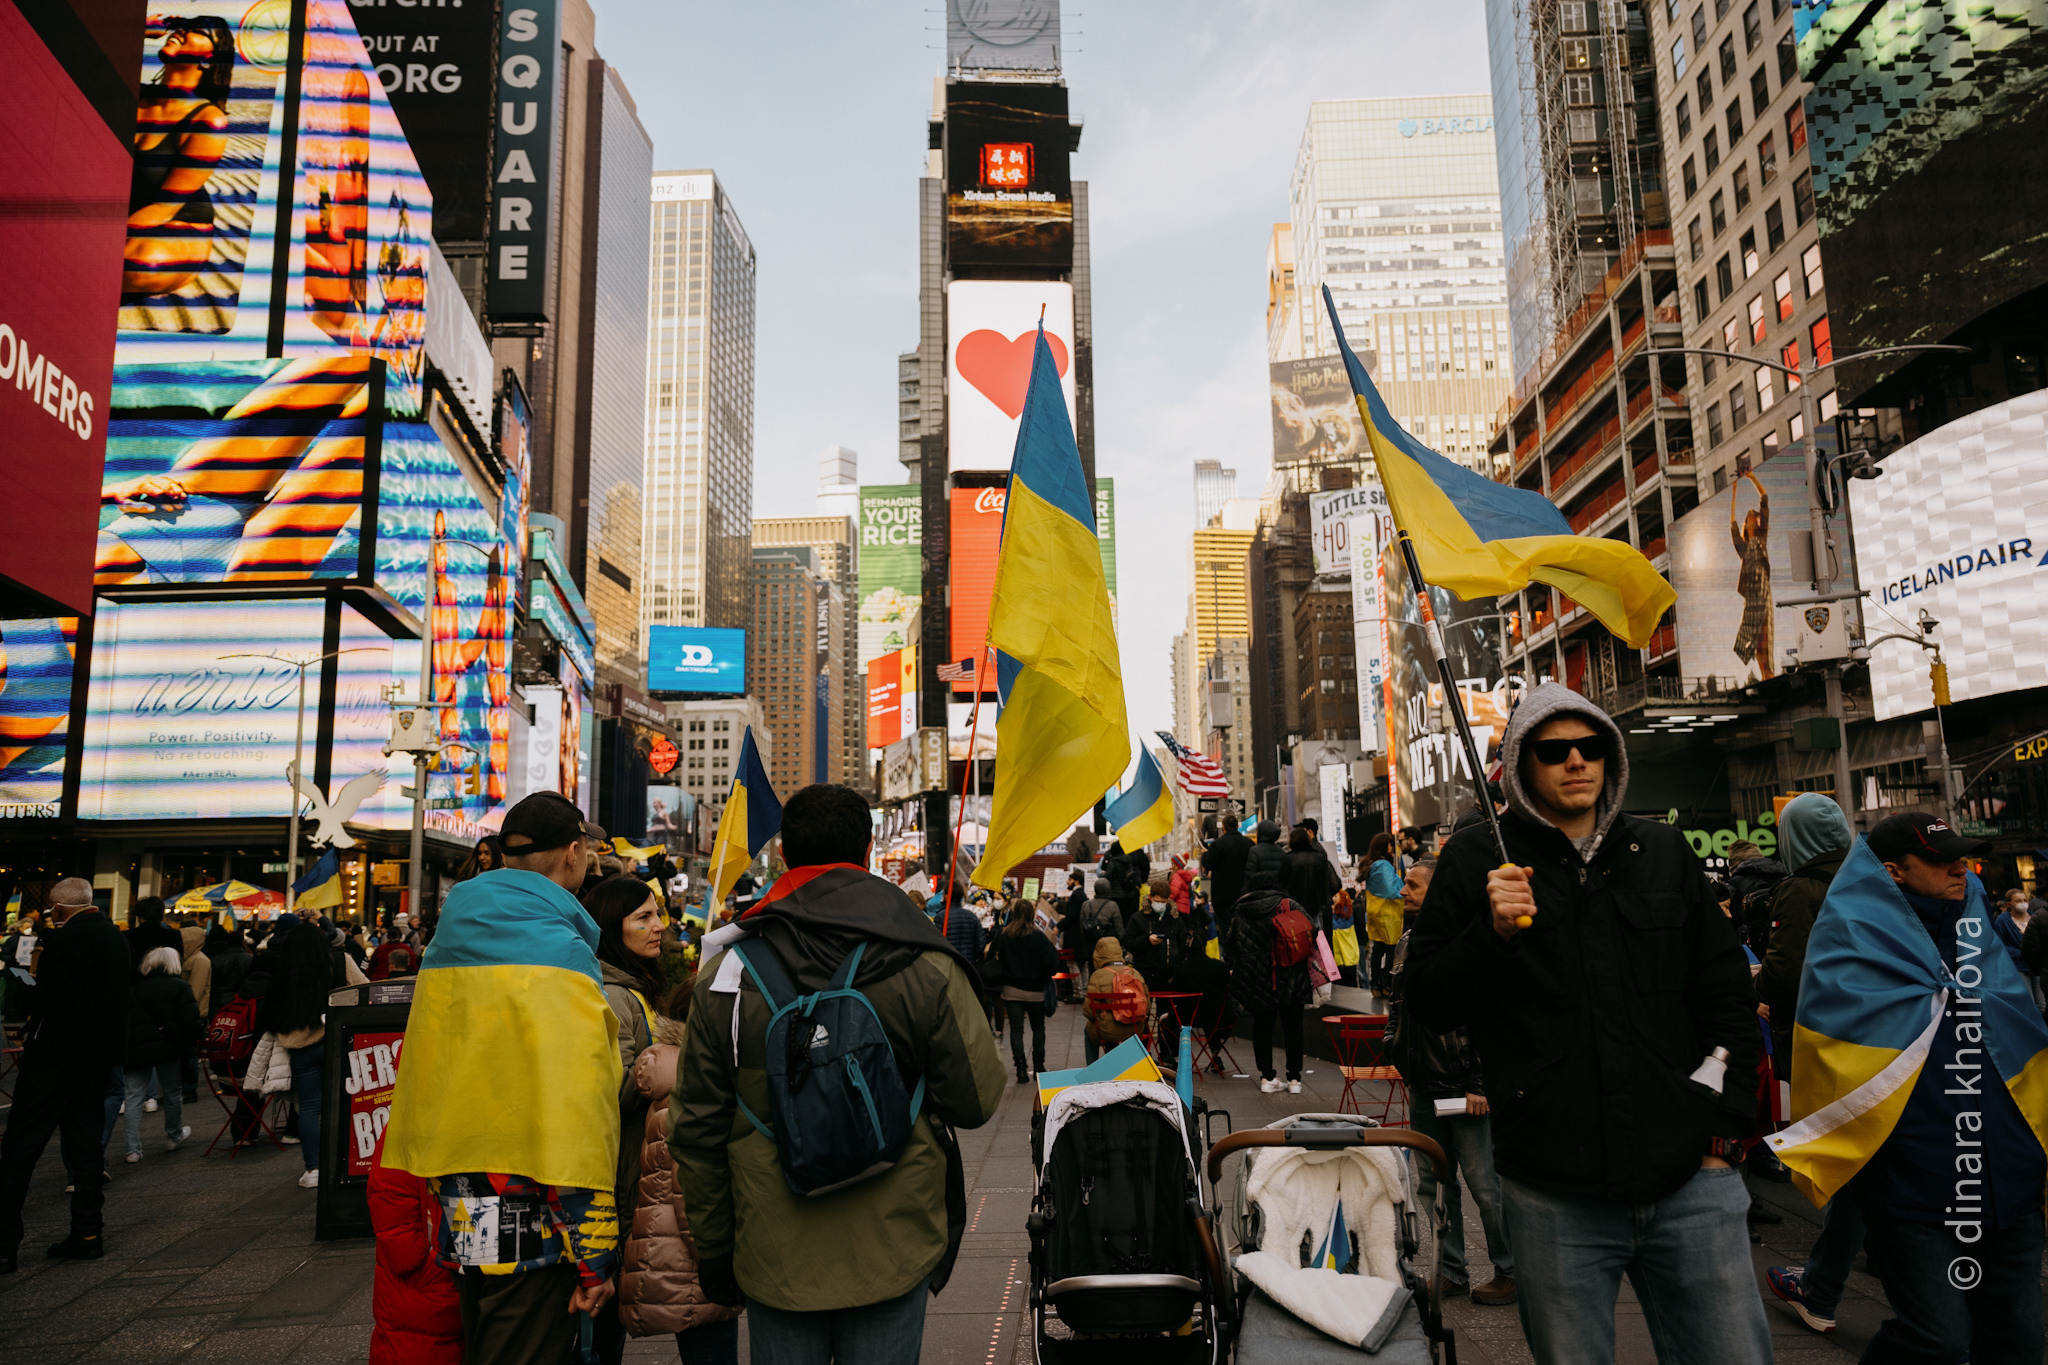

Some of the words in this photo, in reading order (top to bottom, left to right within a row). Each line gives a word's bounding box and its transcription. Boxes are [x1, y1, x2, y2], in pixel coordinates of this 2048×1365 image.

[411, 36, 440, 52] AT
[497, 9, 541, 280] SQUARE
[963, 190, 996, 201] Xinhua
[996, 190, 1028, 201] Screen
[1028, 191, 1056, 202] Media
[0, 323, 94, 441] OMERS
[1291, 370, 1324, 394] Harry
[863, 496, 922, 508] REIMAGINE
[1322, 491, 1366, 520] LITTLE
[863, 507, 923, 525] YOUR
[863, 524, 923, 546] RICE
[1360, 532, 1374, 581] 7,000
[1882, 537, 2033, 605] ICELANDAIR
[1363, 587, 1376, 605] SF
[675, 665, 719, 674] DAKTRONICS
[1406, 690, 1428, 740] NO
[149, 731, 198, 743] Power.
[204, 729, 277, 744] Positivity.
[154, 749, 175, 761] No
[180, 747, 270, 762] retouching.
[928, 731, 942, 787] HELLO!
[443, 799, 453, 808] 46
[353, 1105, 392, 1159] BO
